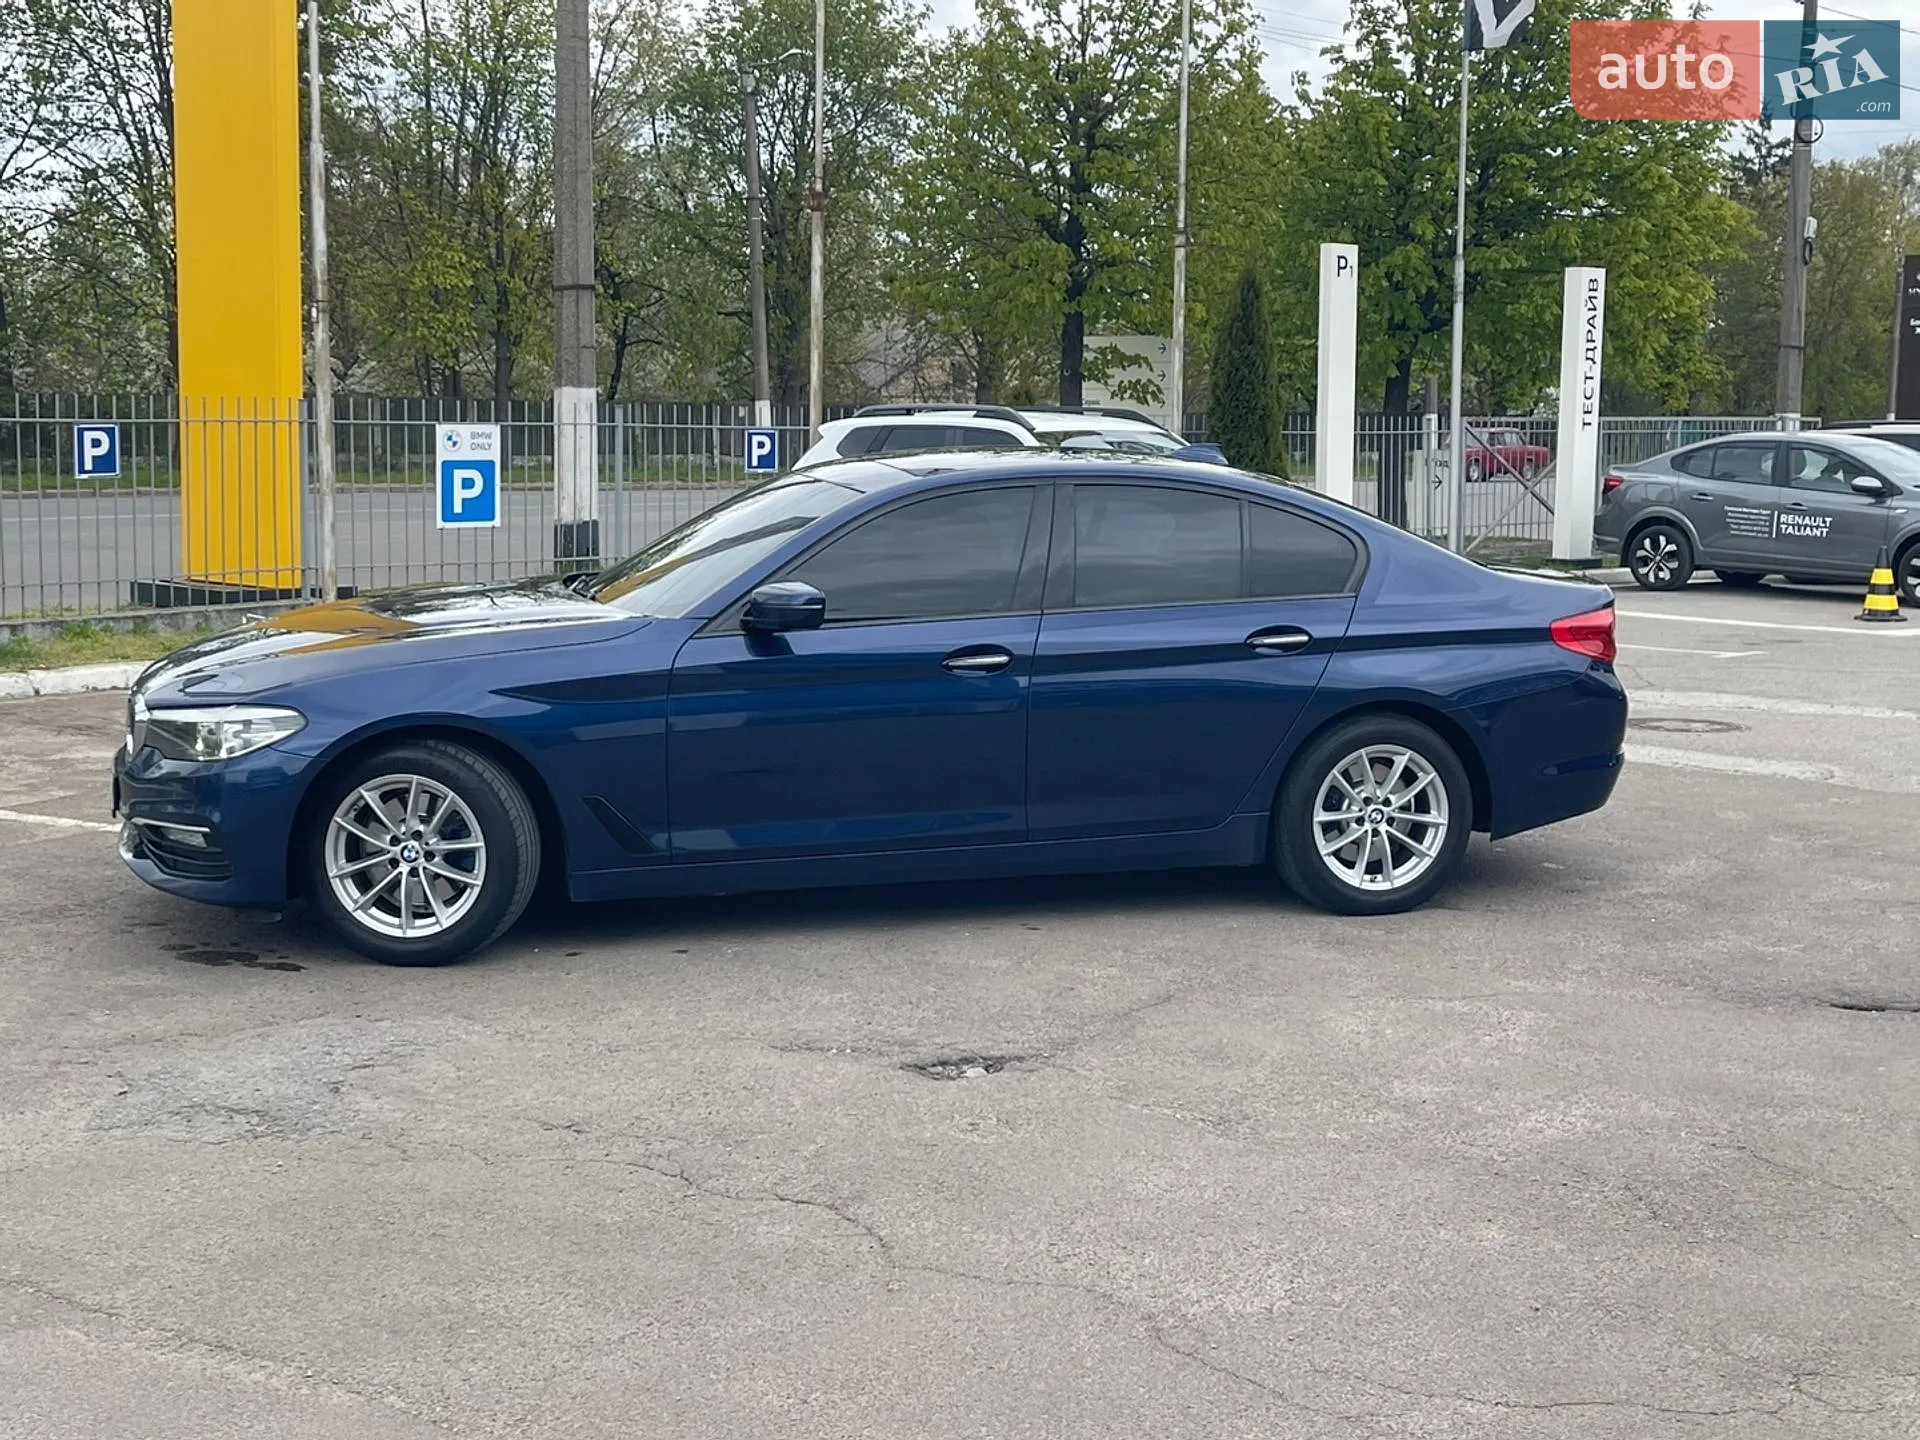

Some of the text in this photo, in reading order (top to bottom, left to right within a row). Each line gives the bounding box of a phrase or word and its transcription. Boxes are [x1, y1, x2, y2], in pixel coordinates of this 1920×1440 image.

[1582, 278, 1599, 431] ТЕСТ-ДРАЙВ
[470, 431, 492, 440] BMW
[470, 442, 492, 451] ONLY
[83, 431, 110, 470] P
[752, 435, 771, 467] P
[453, 469, 484, 514] P
[1780, 513, 1832, 527] RENAULT
[1780, 524, 1829, 537] TALIANT
